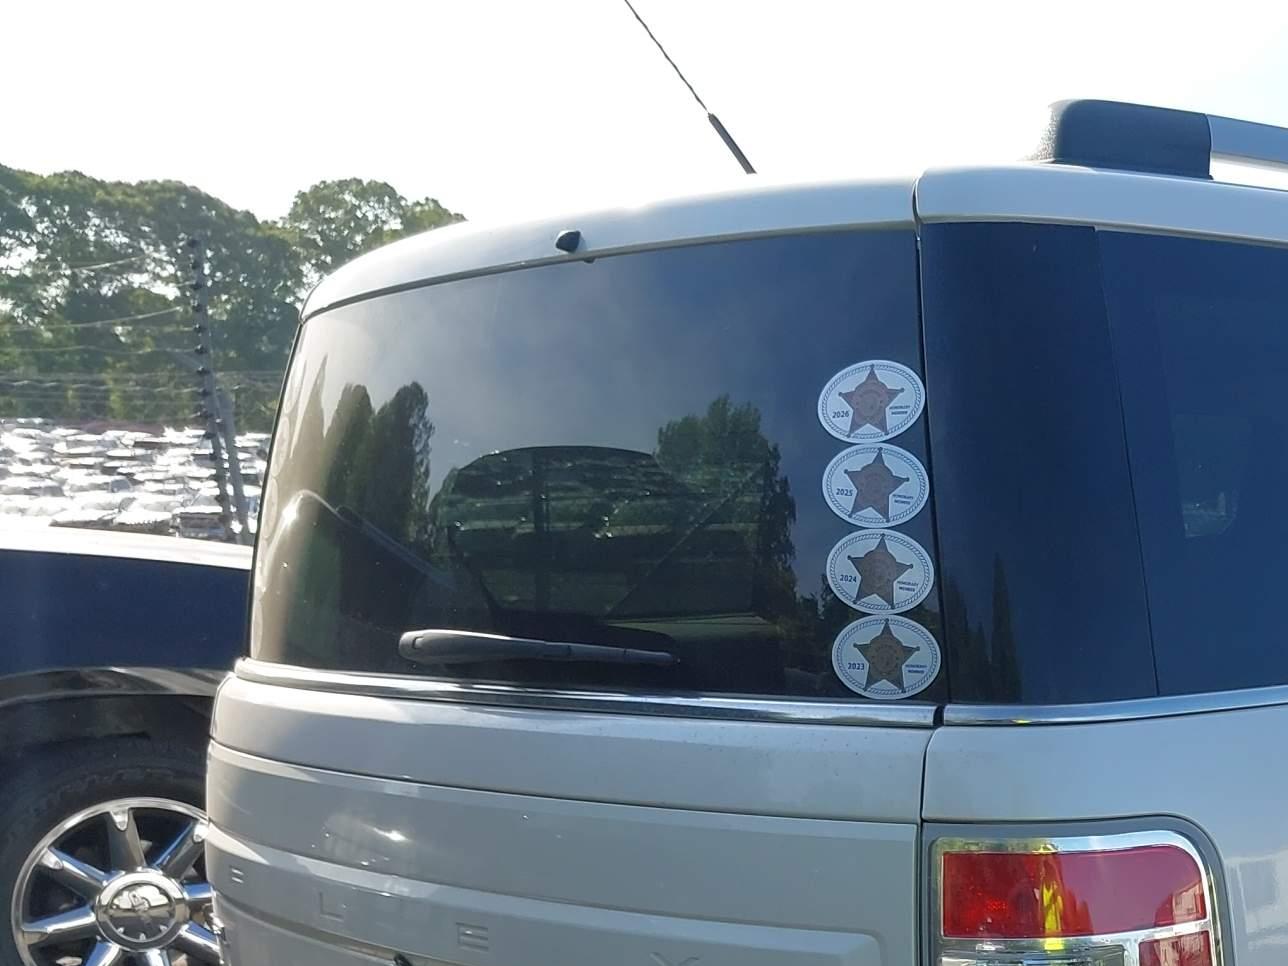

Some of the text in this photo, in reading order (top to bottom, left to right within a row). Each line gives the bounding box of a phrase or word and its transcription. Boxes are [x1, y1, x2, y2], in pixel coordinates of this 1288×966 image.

[831, 409, 850, 419] 2026
[836, 487, 854, 497] 2025
[839, 574, 857, 583] 2024
[847, 662, 865, 671] 2023
